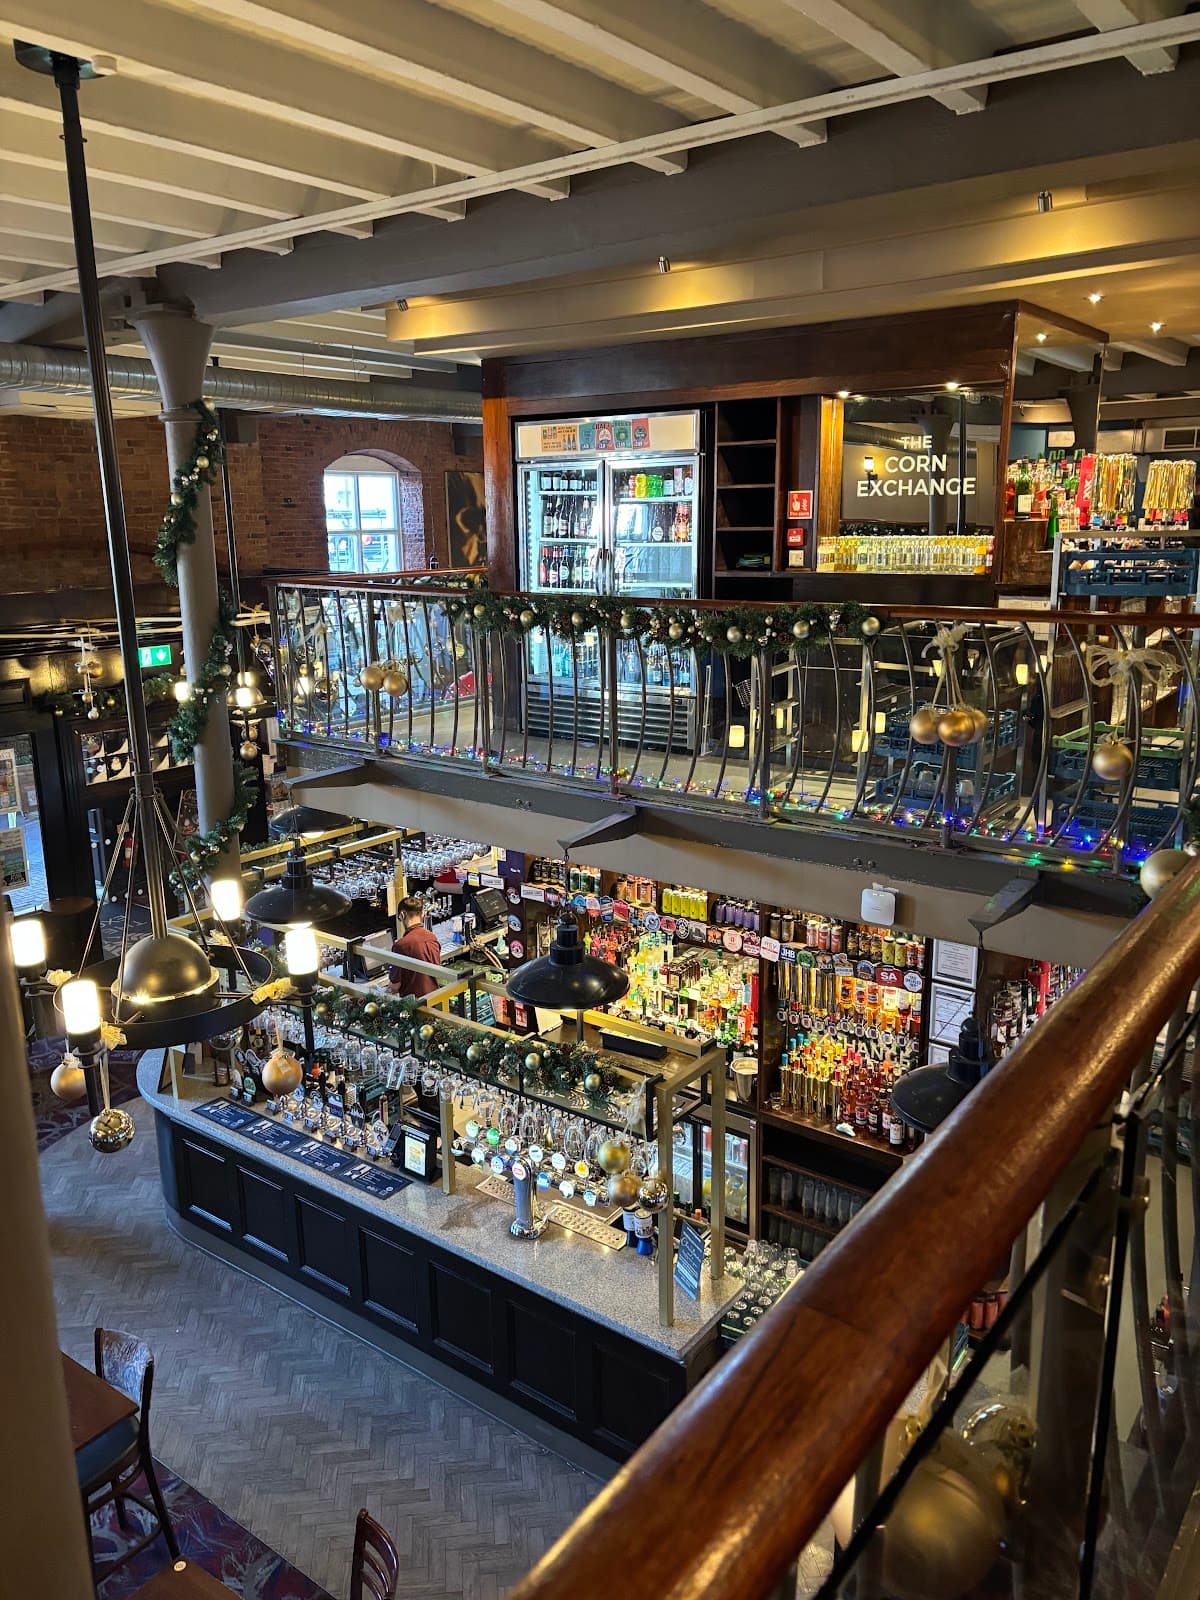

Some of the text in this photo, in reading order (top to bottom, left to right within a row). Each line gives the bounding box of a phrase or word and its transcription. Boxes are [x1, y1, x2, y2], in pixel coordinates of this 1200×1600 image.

[900, 435, 933, 450] THE
[884, 454, 947, 473] CORN
[856, 477, 977, 497] EXCHANGE
[780, 947, 796, 959] JHB
[880, 971, 897, 981] SA
